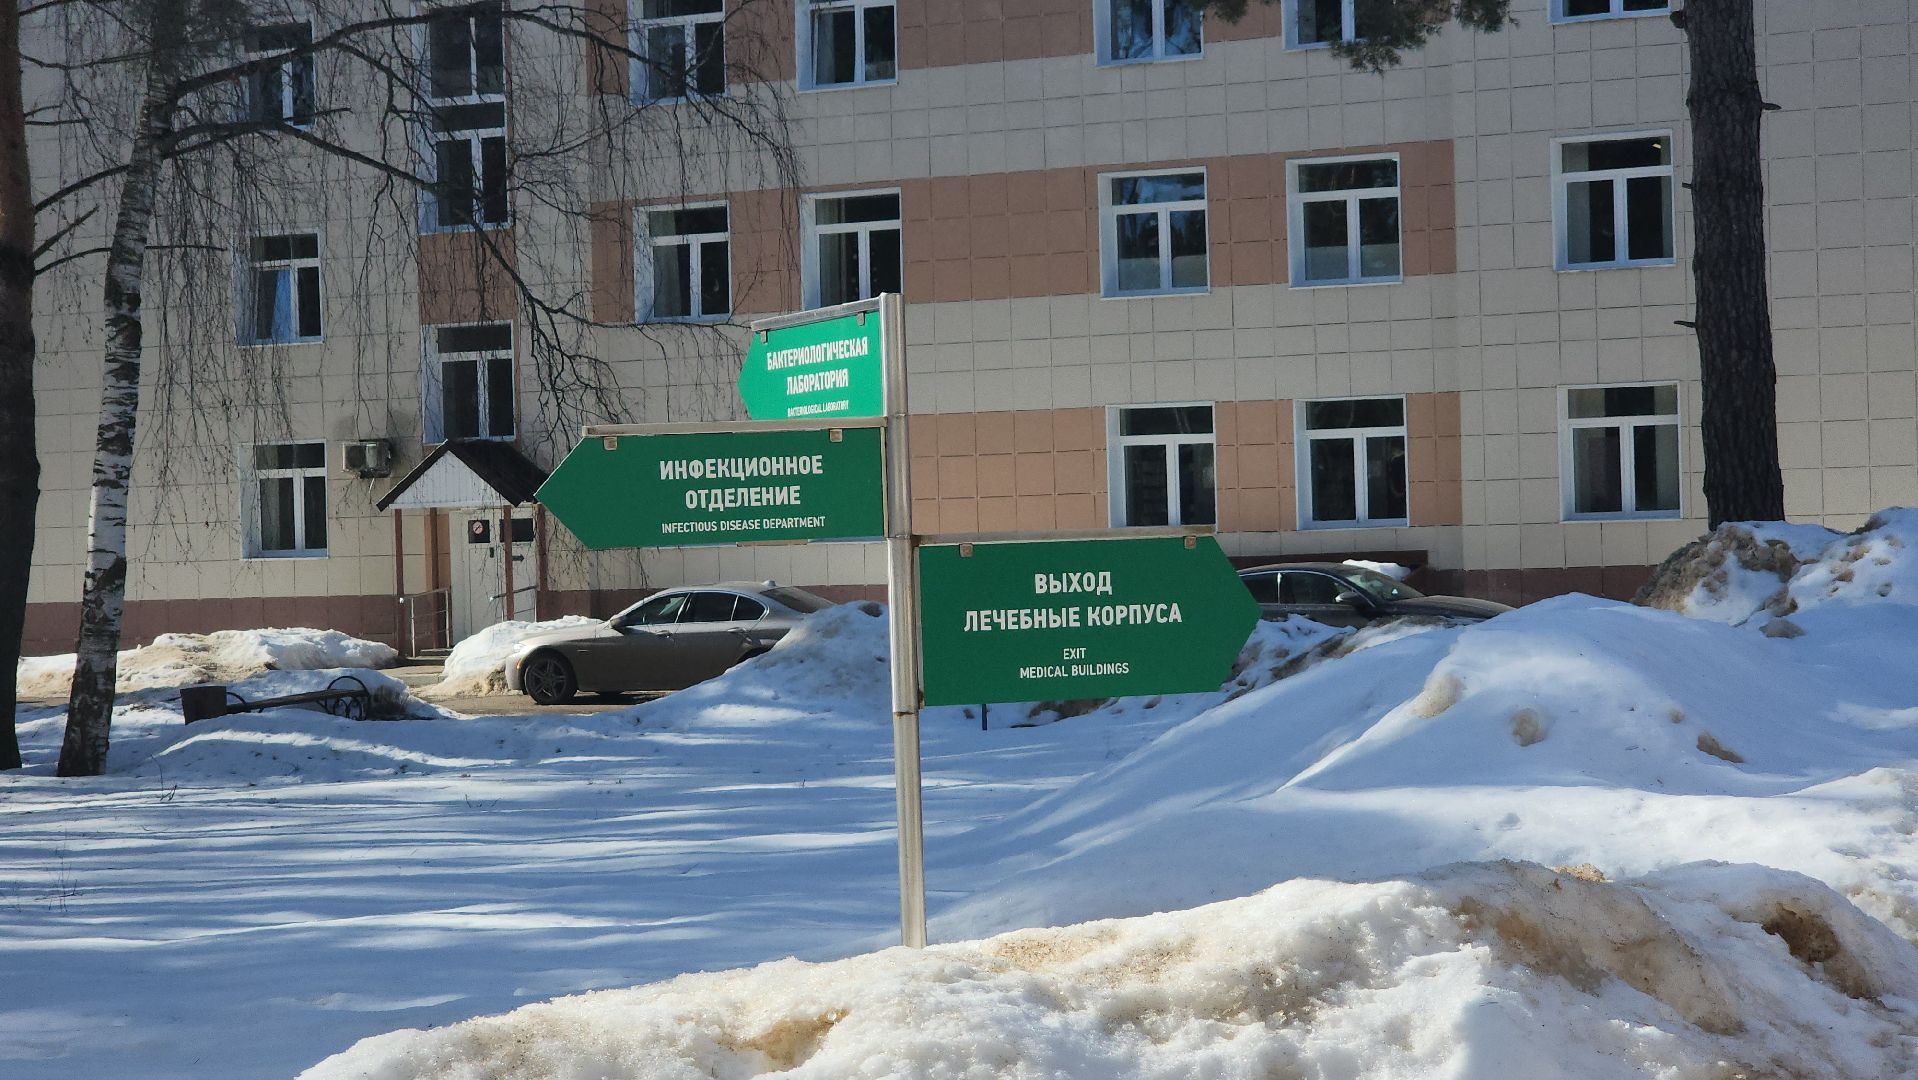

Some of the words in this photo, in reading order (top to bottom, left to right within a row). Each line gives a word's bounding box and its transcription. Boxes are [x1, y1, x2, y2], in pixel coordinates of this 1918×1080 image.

[766, 336, 868, 370] БАКТЕРИОЛОГИЧЕСКАЯ
[786, 368, 849, 396] ЛАБОРАТОРИЯ
[659, 455, 824, 481] ИНФЕКЦИОННОЕ
[685, 485, 801, 512] ОТДЕЛЕНИЕ
[661, 521, 718, 534] INFECTIOUS
[719, 518, 761, 531] DISEASE
[762, 515, 826, 529] DEPARTMENT
[1034, 571, 1113, 596] ВЫХОД
[963, 606, 1081, 632] ЛЕЧЕБНЫЕ
[1087, 602, 1183, 627] КОРПУСА
[1063, 647, 1087, 660] EXIT
[1019, 665, 1069, 679] MEDICAL
[1070, 662, 1130, 677] BUILDINGS
